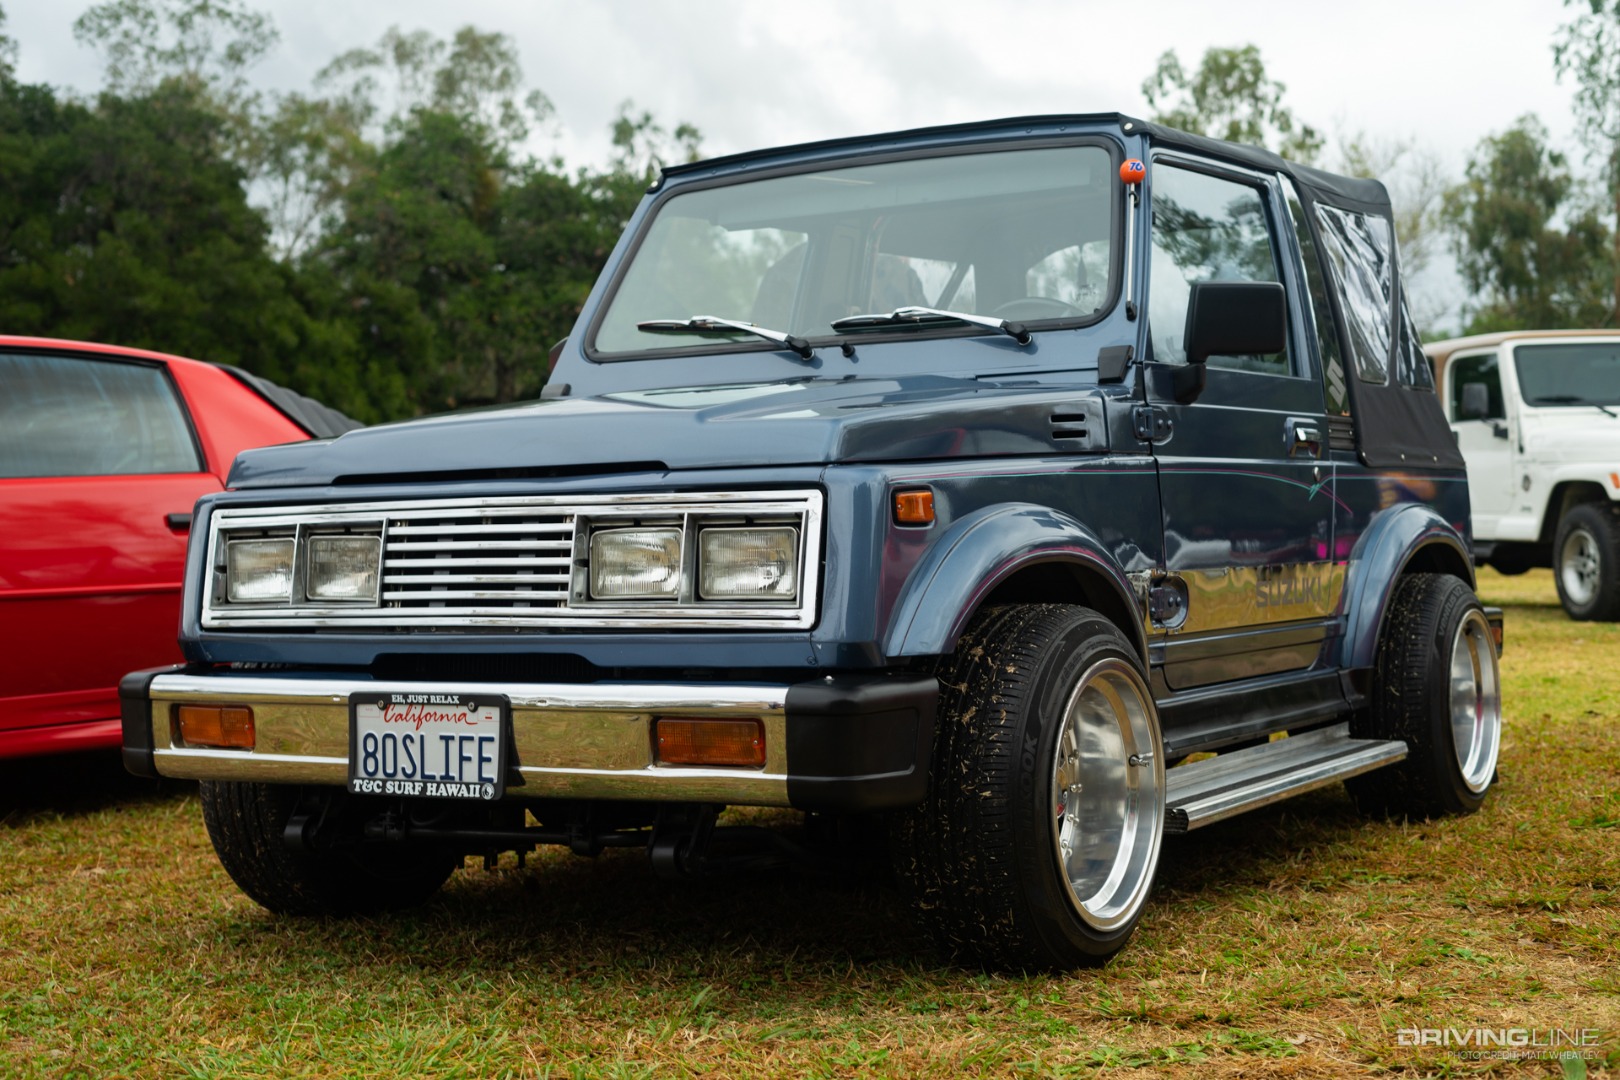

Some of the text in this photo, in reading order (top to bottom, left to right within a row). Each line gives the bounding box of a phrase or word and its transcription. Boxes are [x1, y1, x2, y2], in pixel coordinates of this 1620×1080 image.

[1129, 161, 1143, 172] 76
[1256, 576, 1322, 608] SUZUKI
[391, 694, 460, 704] EH, JUST RELAX
[383, 703, 478, 731] California
[353, 779, 383, 793] T&C
[385, 781, 424, 796] SURF
[426, 783, 481, 797] HAWAII
